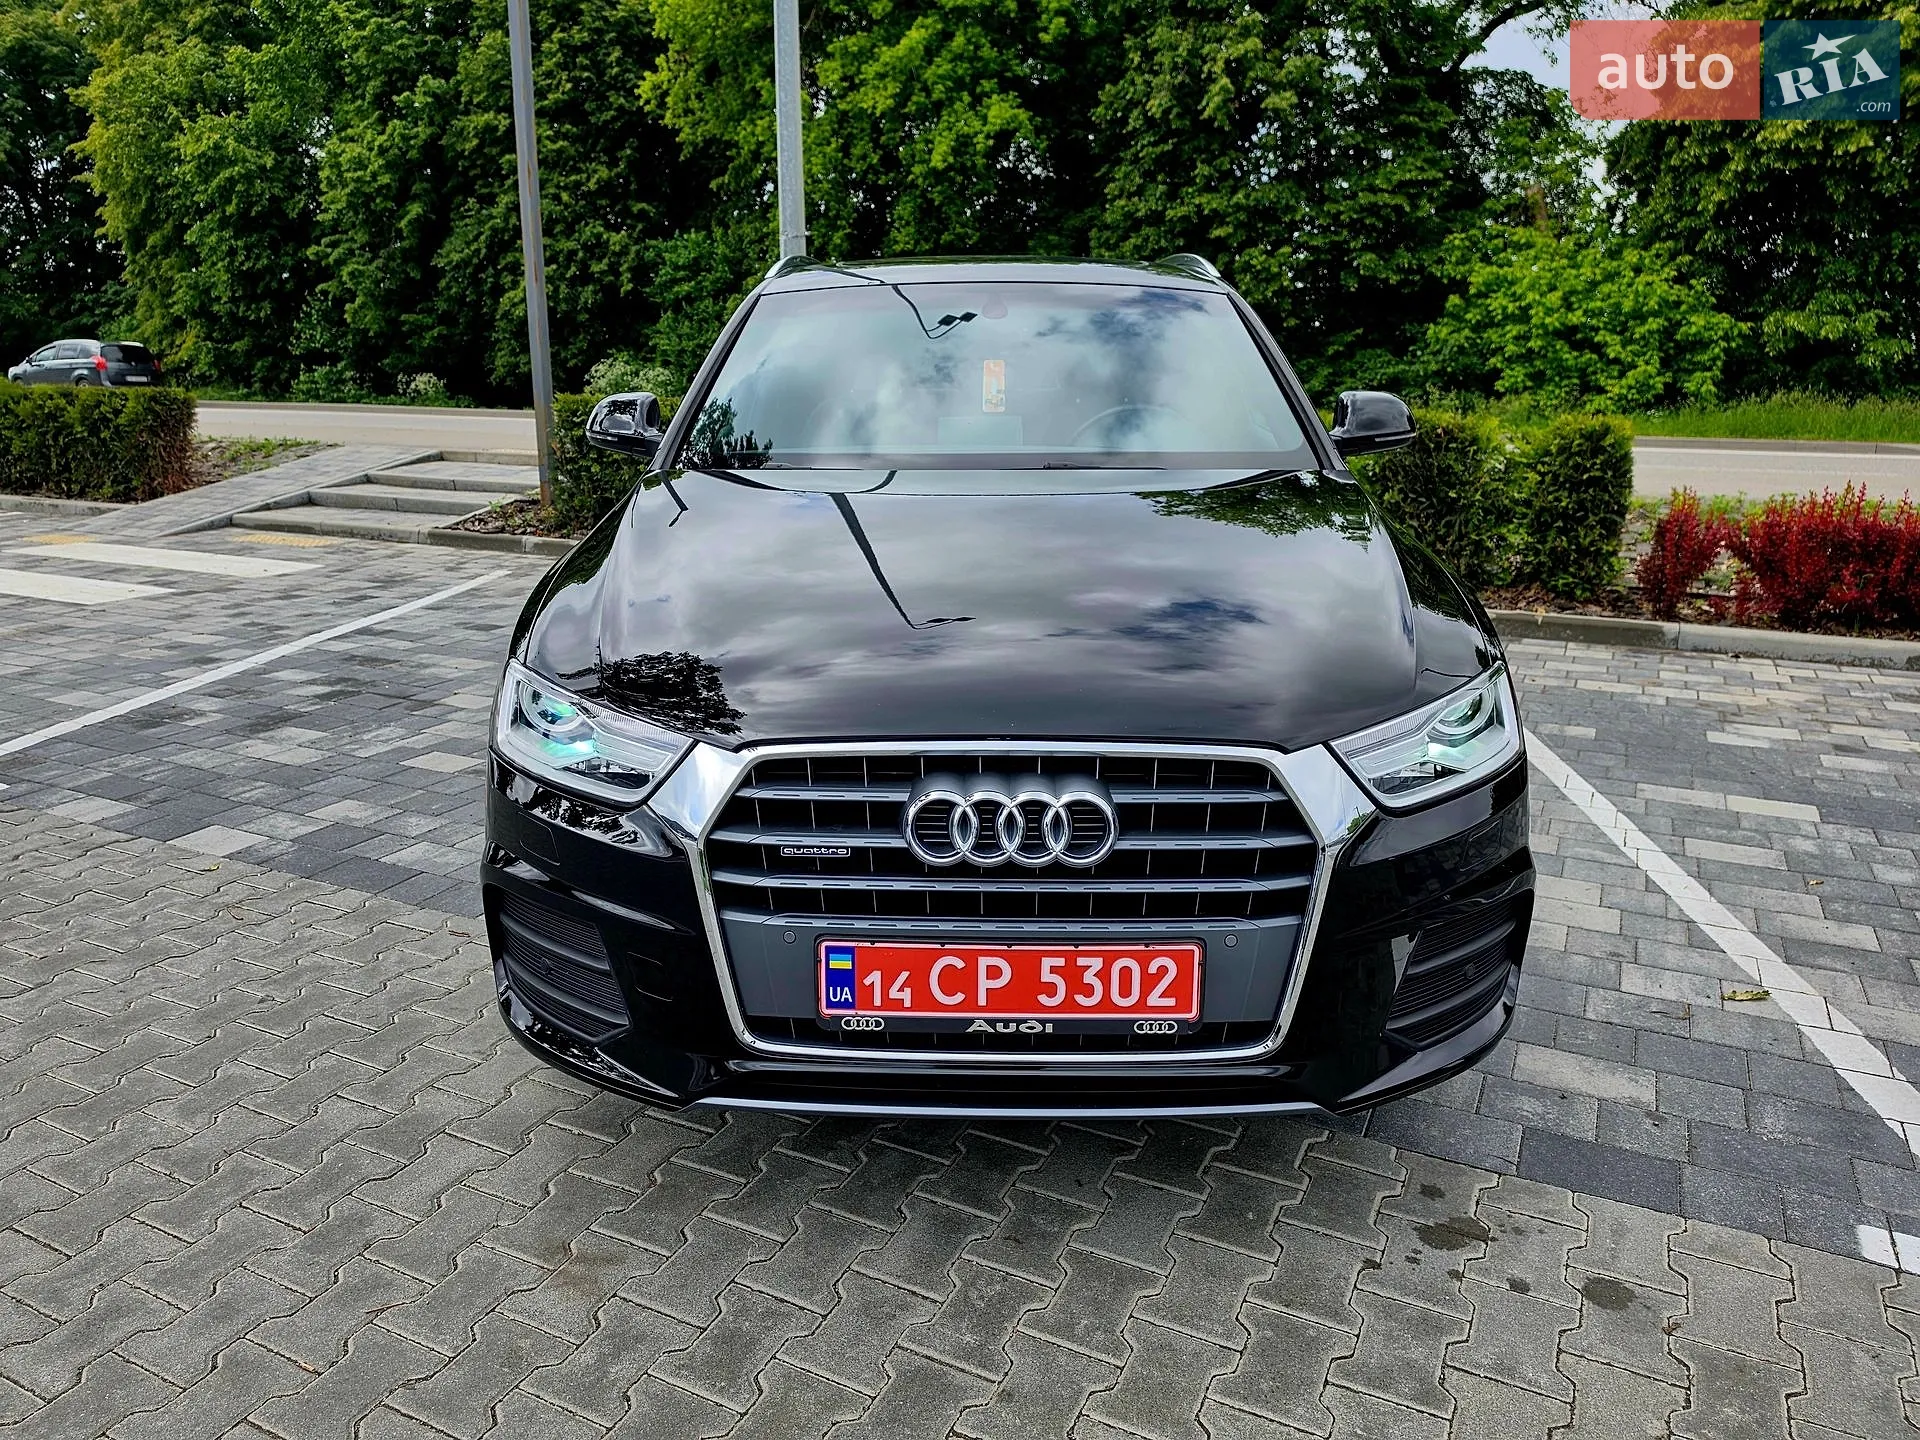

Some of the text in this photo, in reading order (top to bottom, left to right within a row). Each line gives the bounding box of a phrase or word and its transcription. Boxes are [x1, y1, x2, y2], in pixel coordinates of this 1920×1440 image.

[783, 847, 847, 855] quattro
[862, 955, 1178, 1008] 14 CP 5302
[829, 986, 853, 1003] UA
[965, 1019, 1053, 1034] Audi
